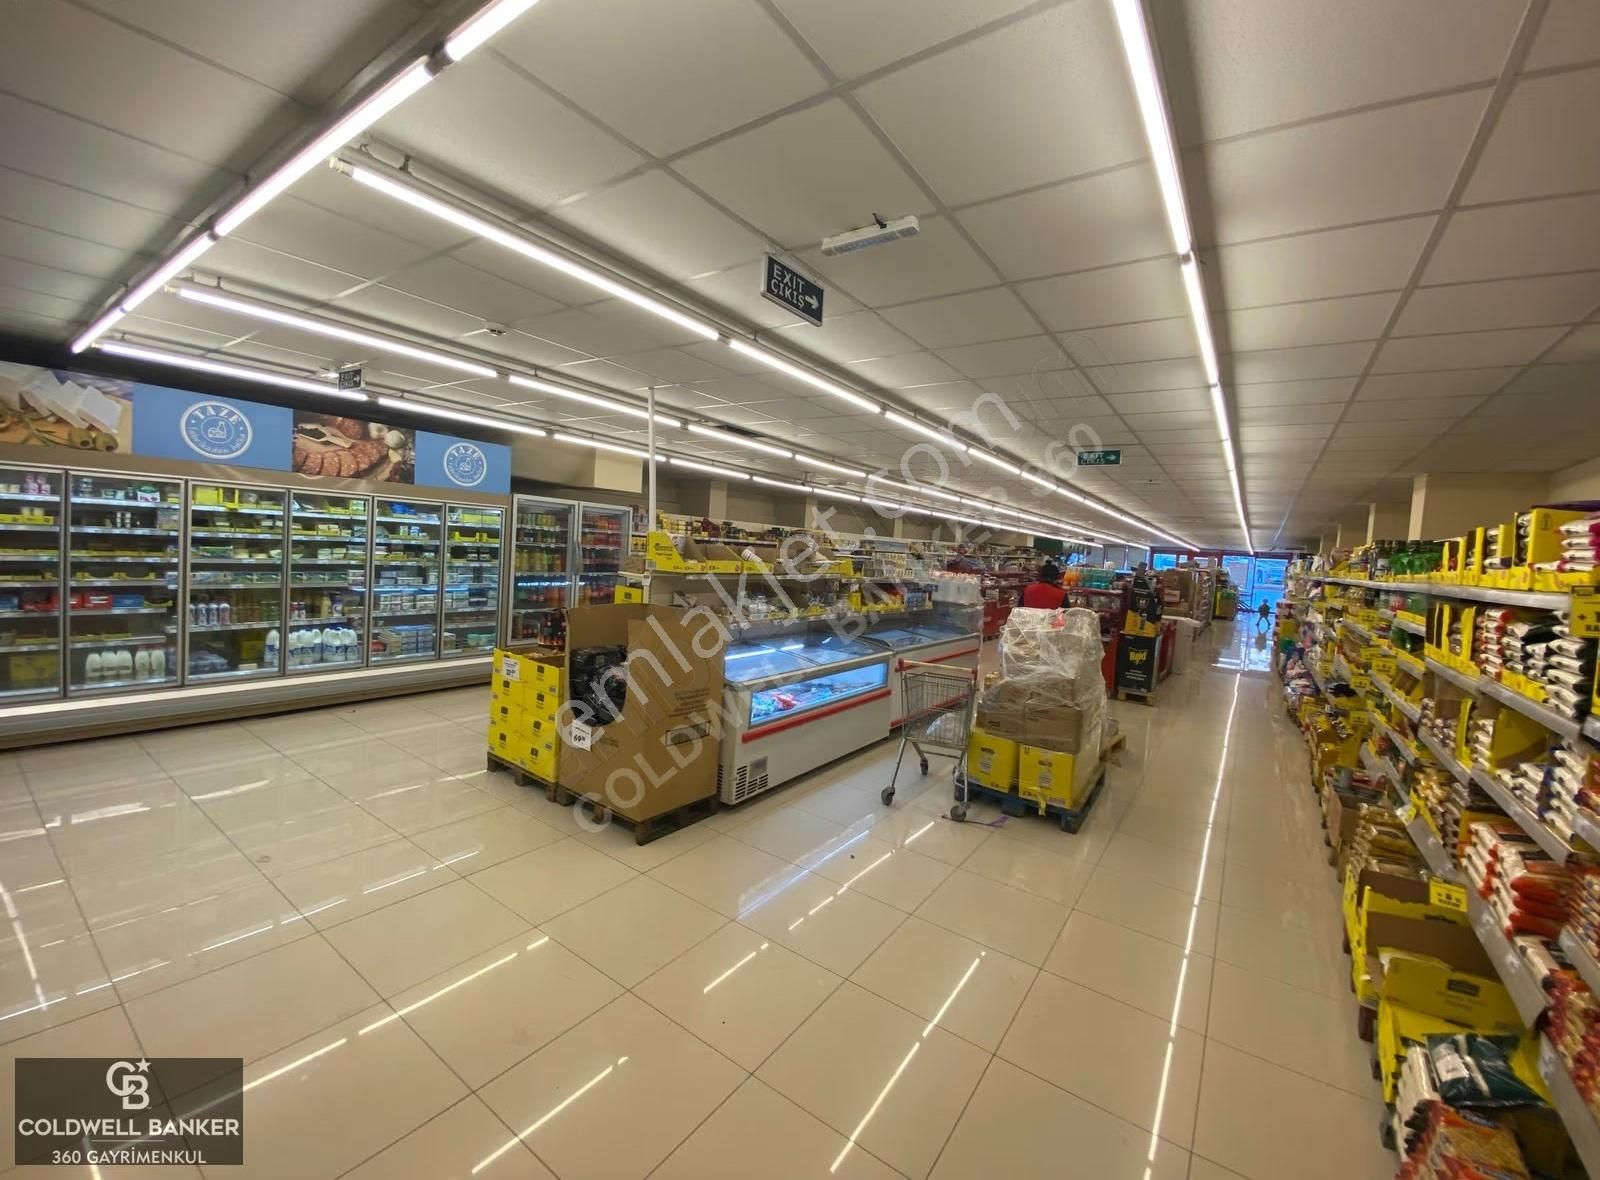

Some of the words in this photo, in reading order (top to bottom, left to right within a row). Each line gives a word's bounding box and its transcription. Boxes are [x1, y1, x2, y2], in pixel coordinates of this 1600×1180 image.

[774, 263, 805, 293] EXIT
[192, 405, 242, 425] TAZE
[450, 446, 481, 460] TAZE
